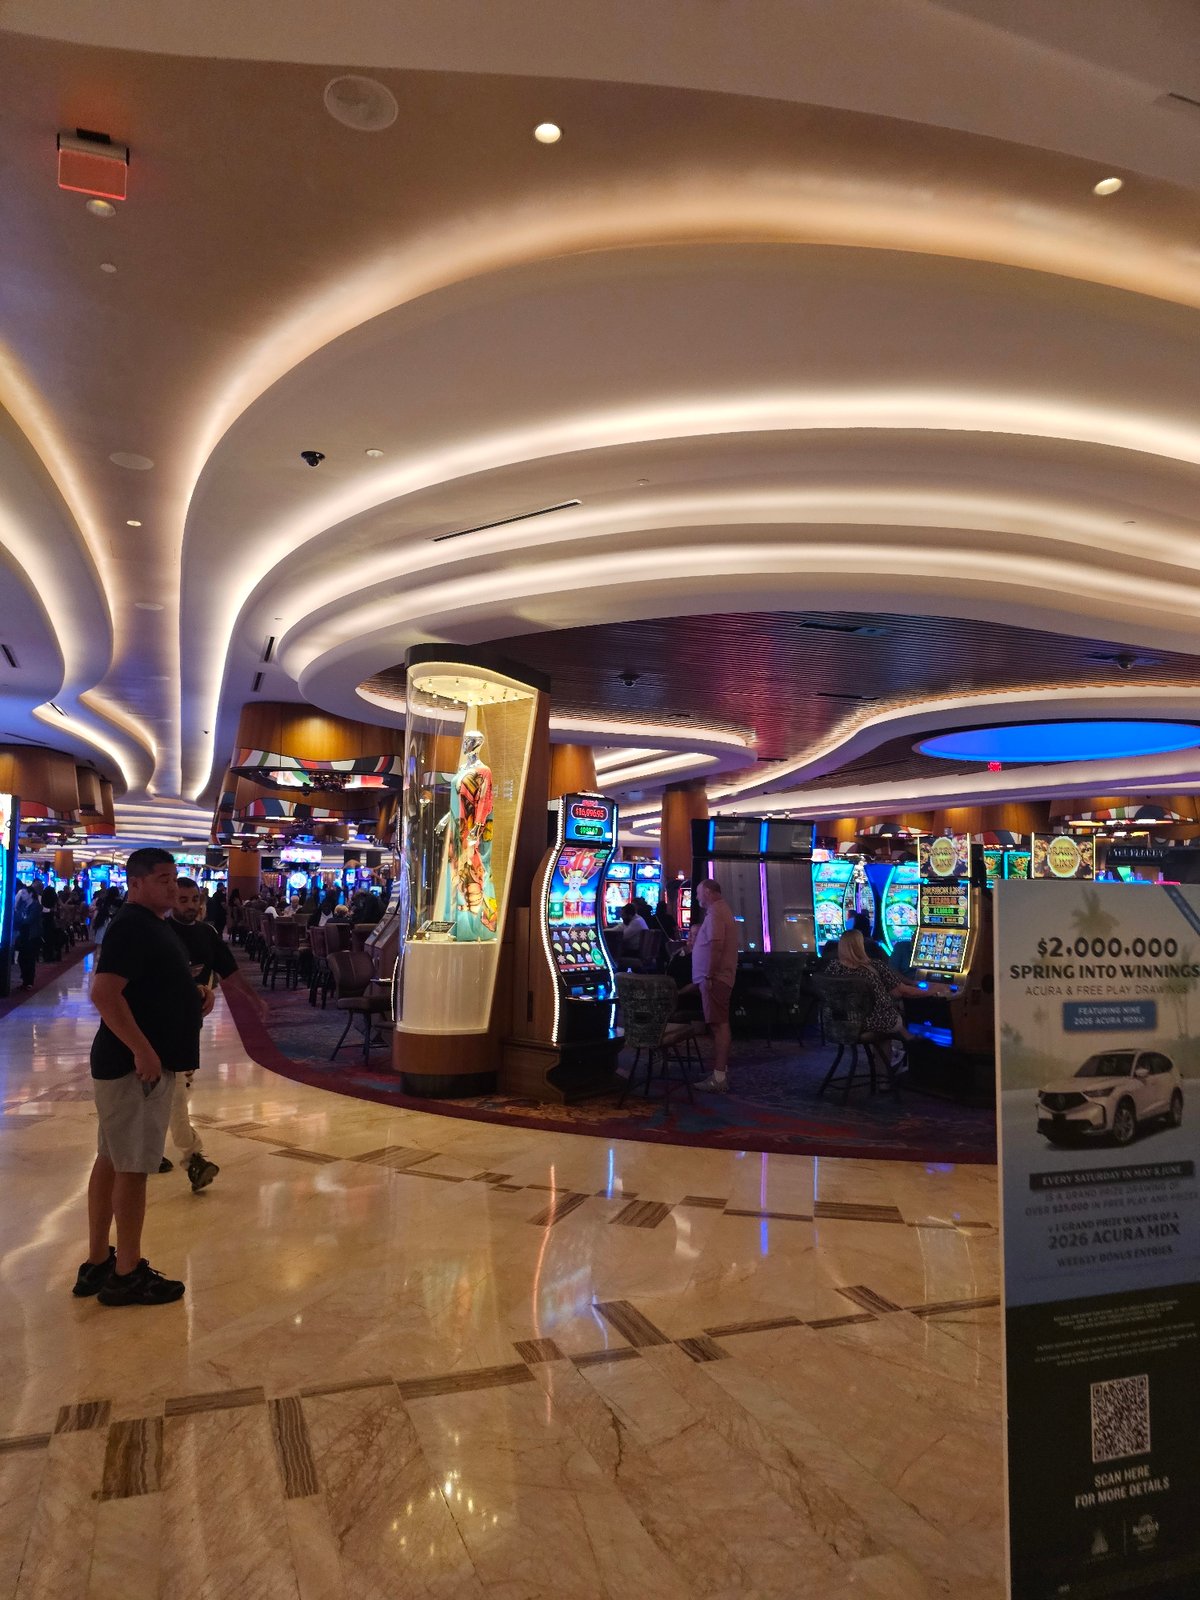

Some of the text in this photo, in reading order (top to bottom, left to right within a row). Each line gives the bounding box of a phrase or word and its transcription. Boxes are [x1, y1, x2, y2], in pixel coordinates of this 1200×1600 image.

[1037, 936, 1178, 958] $2,000,000
[1010, 963, 1200, 980] SPRING INTO WINNINGS
[1025, 984, 1189, 996] ACURA & FREE PLAY DRAWINGS
[1078, 1006, 1121, 1015] FEATURING
[1042, 1176, 1072, 1185] EVERY
[1074, 1172, 1120, 1183] SATURDAY
[1122, 1171, 1132, 1179] IN
[1133, 1168, 1152, 1178] MAY
[1160, 1166, 1182, 1175] JUNE
[1065, 1190, 1096, 1200] GRAND
[1099, 1187, 1124, 1196] PRIZE
[1126, 1184, 1166, 1194] DRAWING
[1025, 1206, 1049, 1216] OVER
[1103, 1199, 1124, 1209] FREE
[1127, 1196, 1147, 1206] PLAY
[1150, 1194, 1168, 1203] AND
[1062, 1220, 1095, 1231] GRAND
[1097, 1217, 1121, 1227] PRIZE
[1123, 1214, 1158, 1225] WINNER
[1048, 1223, 1181, 1249] 2026 ACURA MDX
[1057, 1245, 1173, 1267] WEEKLY BONUS ENTRIES
[1094, 1465, 1150, 1487] SCAN HERE
[1074, 1476, 1170, 1509] FOR MORE DETAILS
